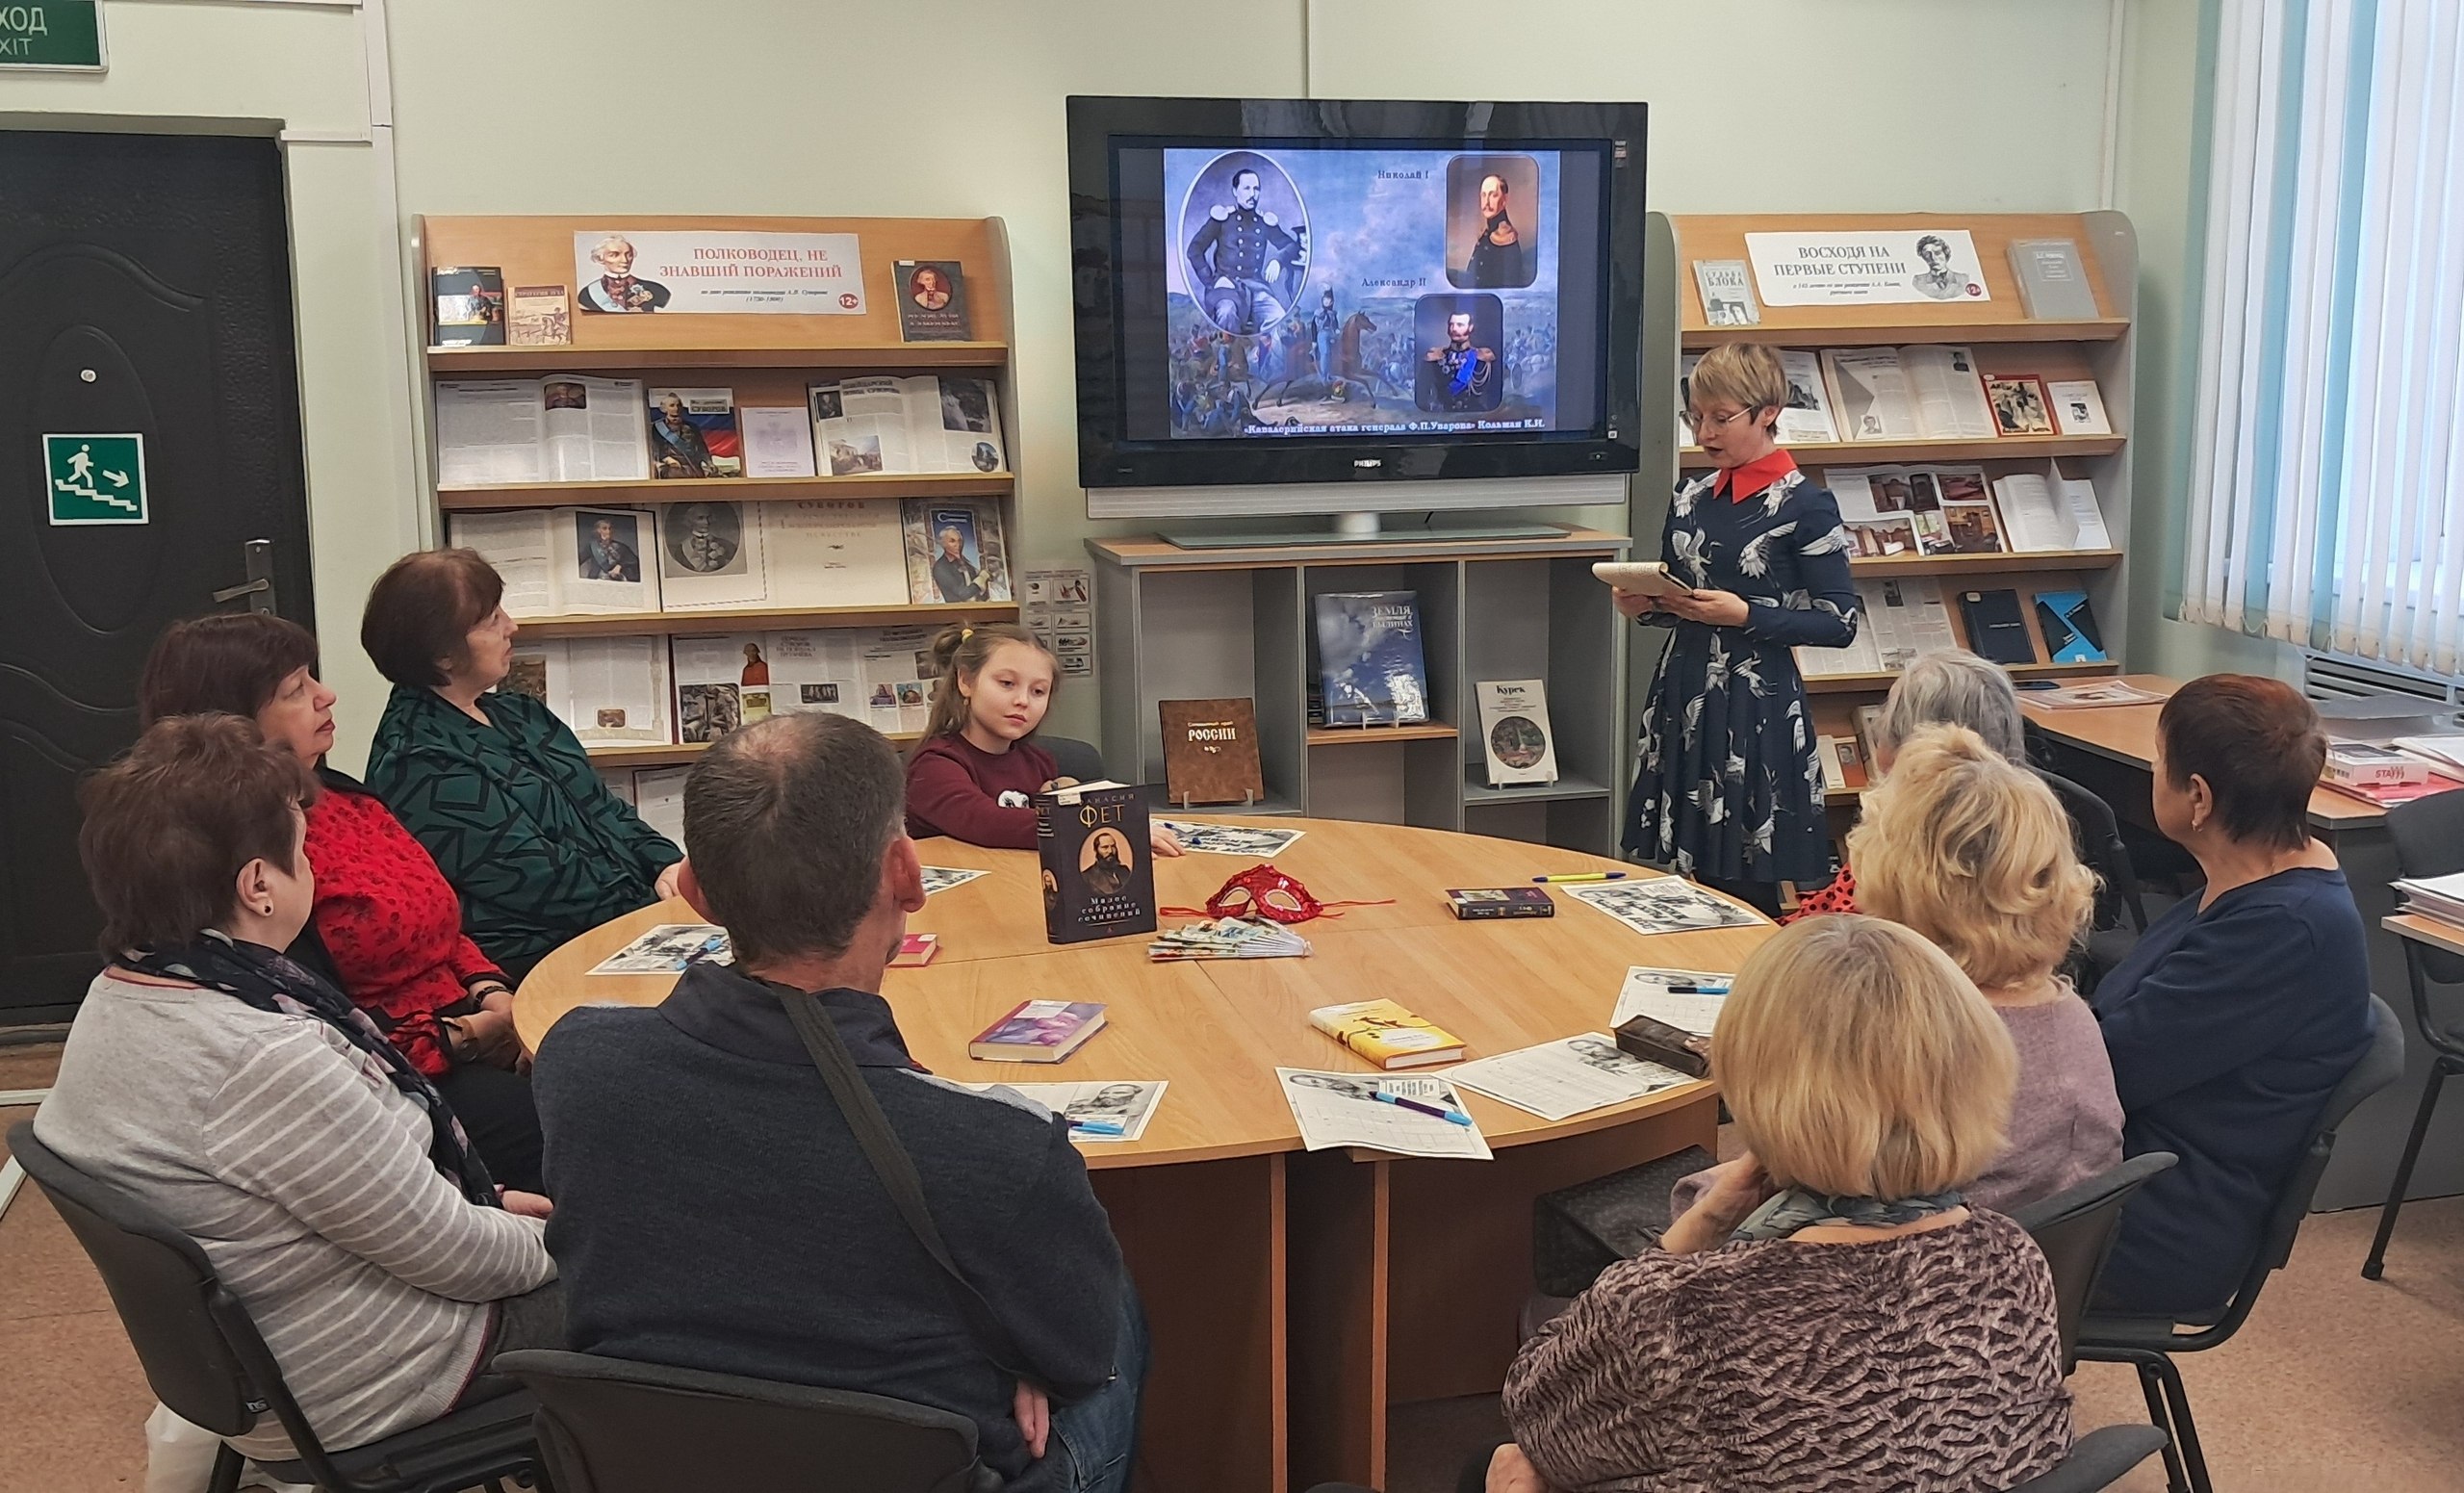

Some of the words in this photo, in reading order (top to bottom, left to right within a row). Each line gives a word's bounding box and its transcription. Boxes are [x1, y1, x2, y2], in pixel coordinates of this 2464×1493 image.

[1377, 170, 1422, 179] Николай
[693, 248, 803, 263] ПОЛКОВОДЕЦ,
[808, 250, 828, 261] НЕ
[1798, 246, 1865, 260] ВОСХОДЯ
[1868, 246, 1889, 258] НА
[659, 264, 739, 277] ЗНАВШИЙ
[743, 265, 842, 278] ПОРАЖЕНИЙ
[1774, 264, 1835, 276] ПЕРВЫЕ
[1838, 262, 1907, 275] СТУПЕНИ
[1361, 278, 1416, 288] Александр
[1707, 277, 1744, 287] БЛОКА
[838, 296, 859, 306] 12+
[1361, 425, 1405, 433] генерала
[1353, 459, 1381, 468] PHILIPS
[1188, 728, 1237, 741] РОССИИ
[1079, 804, 1125, 828] ФЕТ
[1091, 895, 1128, 905] Малое
[1081, 901, 1137, 914] собрание
[1078, 908, 1141, 922] сочинений
